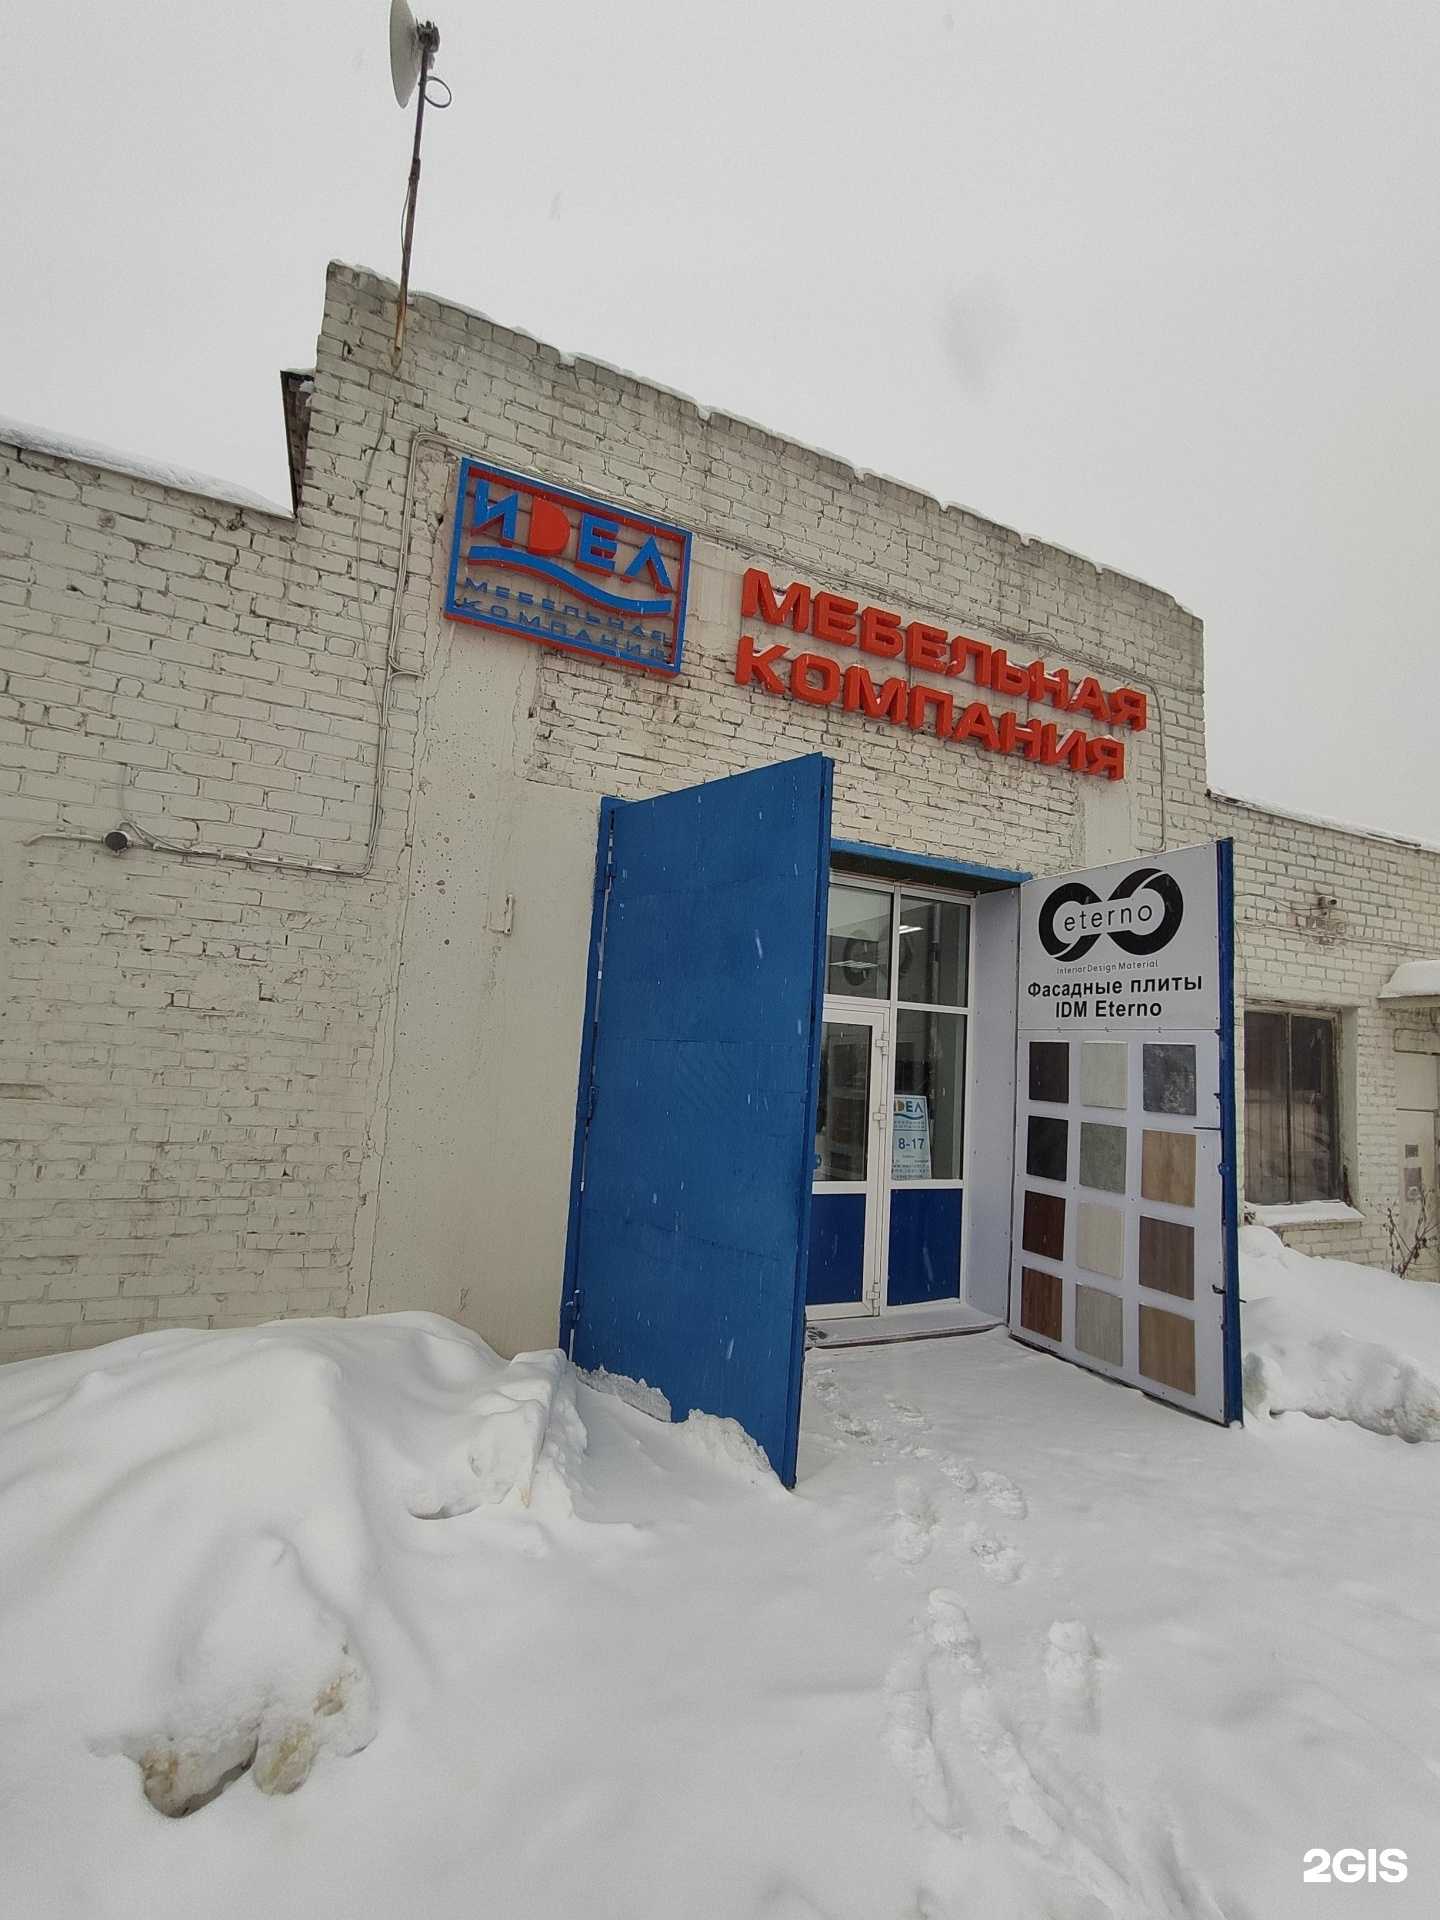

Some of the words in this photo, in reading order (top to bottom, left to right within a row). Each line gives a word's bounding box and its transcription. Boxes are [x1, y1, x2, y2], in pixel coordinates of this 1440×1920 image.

[464, 577, 672, 646] МЕБЕЛЬНАЯ
[460, 597, 667, 660] КОМПАНИЯ
[740, 567, 1147, 732] МЕБЕЛЬНАЯ
[735, 635, 1125, 781] КОМПАНИЯ
[1063, 904, 1153, 932] eterno
[1056, 966, 1086, 975] Interior
[1087, 963, 1117, 974] Design
[1118, 959, 1159, 971] Material
[1027, 979, 1123, 998] Фасадные
[1130, 975, 1202, 993] плиты
[1055, 1000, 1087, 1018] IDM
[1095, 1000, 1162, 1018] Eterno
[898, 1137, 925, 1150] 8-17
